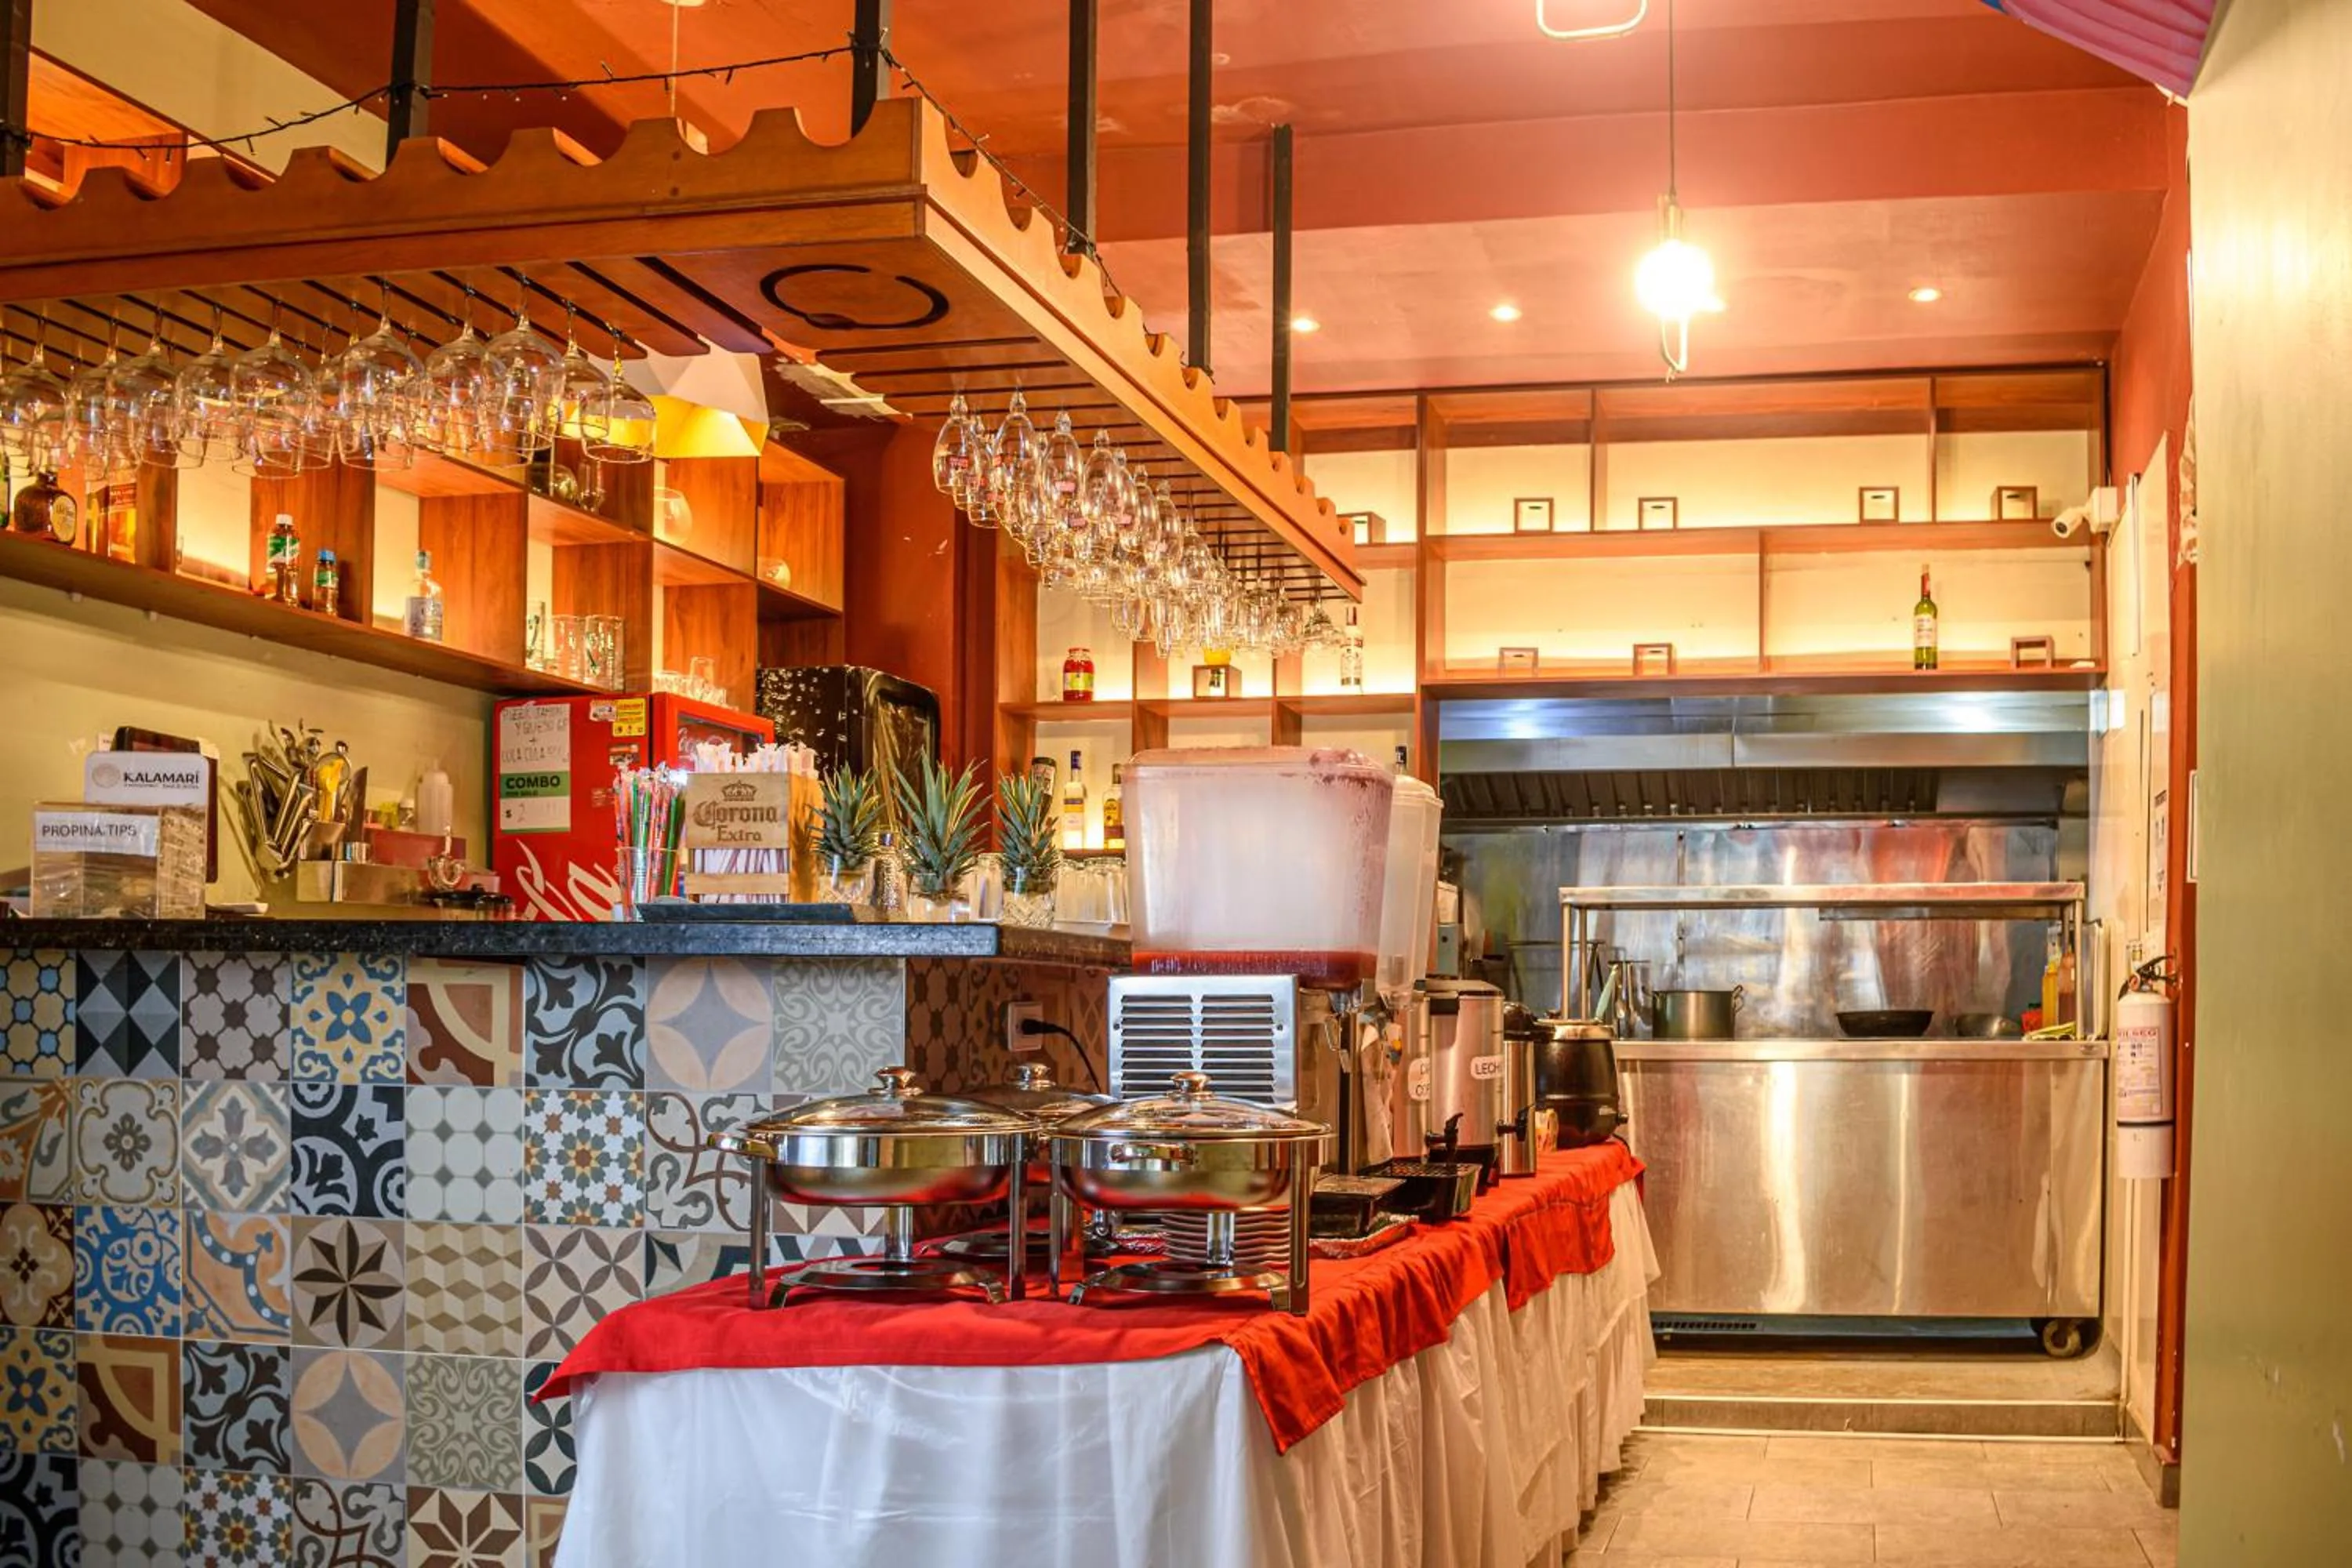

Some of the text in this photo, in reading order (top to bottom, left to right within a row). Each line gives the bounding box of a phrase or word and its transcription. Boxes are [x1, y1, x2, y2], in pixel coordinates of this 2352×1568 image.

[506, 775, 561, 789] COMBO
[693, 800, 779, 829] Corona
[717, 824, 762, 843] Extra
